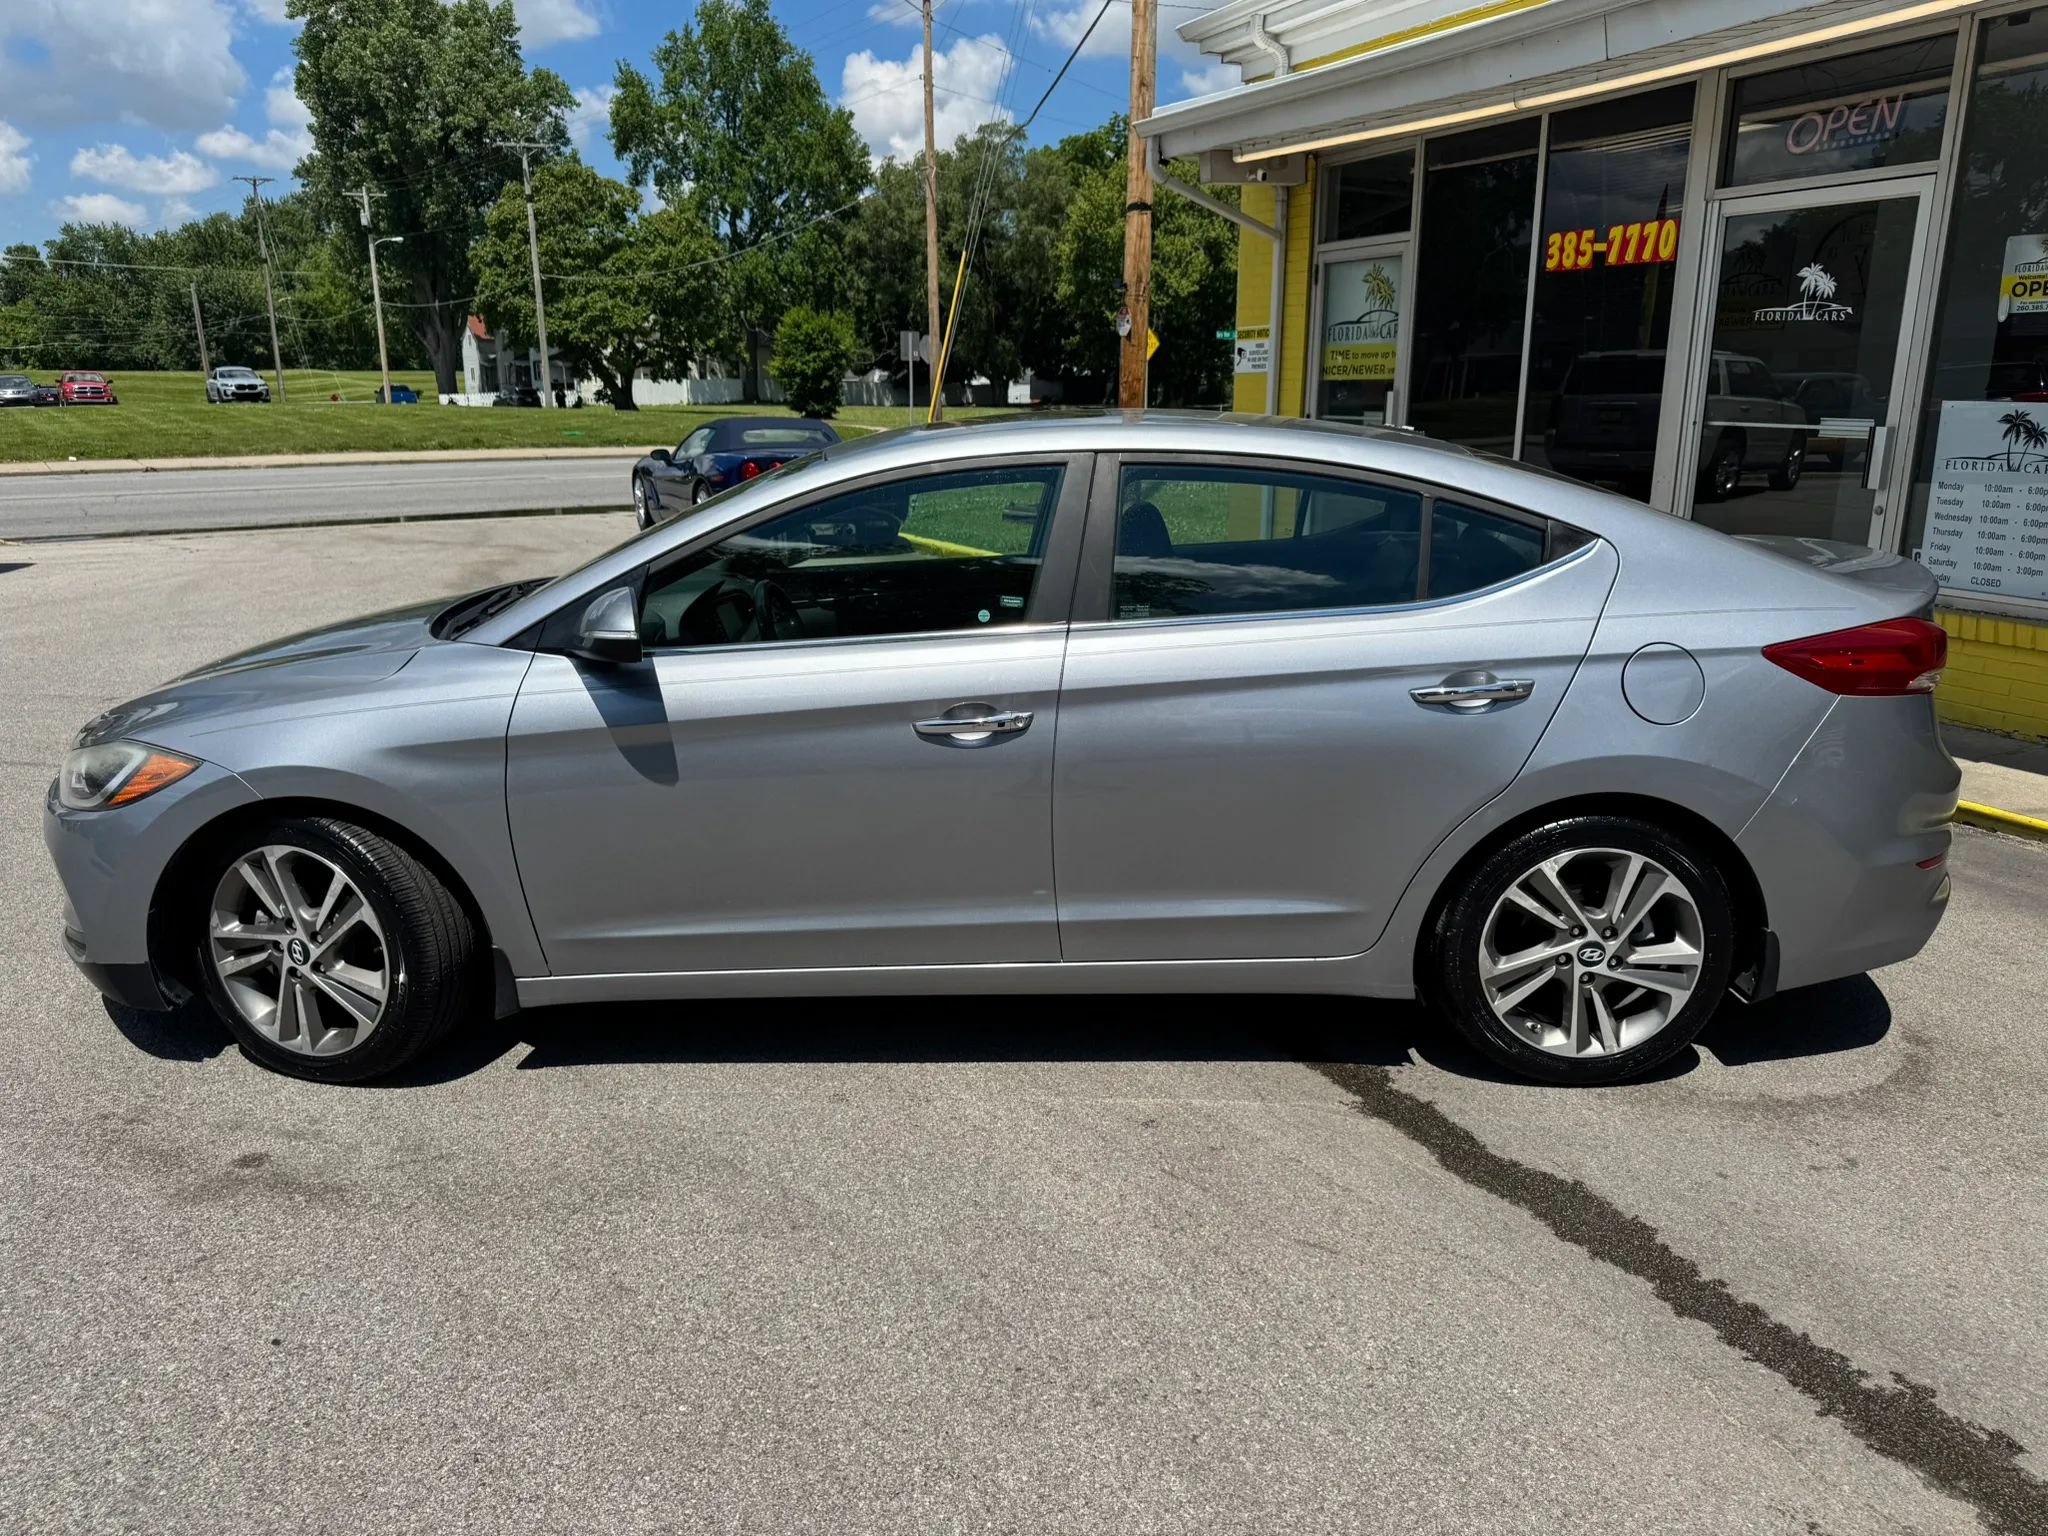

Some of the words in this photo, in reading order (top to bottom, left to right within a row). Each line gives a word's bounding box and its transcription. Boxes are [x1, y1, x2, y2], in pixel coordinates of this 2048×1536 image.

[1786, 93, 1904, 154] OPEN
[1545, 219, 1677, 270] 385-7770
[2015, 264, 2044, 273] FLORIDA
[1754, 311, 1801, 321] FLORIDA
[1815, 311, 1846, 320] CARS
[1257, 328, 1270, 338] NOTIC
[1328, 326, 1368, 342] FLORIDA
[1330, 350, 1351, 360] TIME
[1352, 351, 1359, 359] to
[1361, 351, 1379, 359] move
[1381, 351, 1389, 361] up
[1321, 364, 1386, 377] NICER/NEWER
[1945, 460, 2004, 472] FLORIDA
[1938, 481, 1964, 492] Monday
[1984, 484, 2013, 493] 10:00am
[1936, 496, 1964, 508] Tuesday
[1982, 499, 2011, 509] 10:00am
[1934, 512, 1973, 525] Wednesday
[1980, 515, 2009, 525] 10:00am
[1933, 527, 1963, 539] Thursday
[1978, 531, 2006, 541] 10:00am
[2020, 534, 2048, 545] 6:00pm
[1930, 542, 1951, 553] Friday
[1975, 546, 2004, 556] 10:00am
[2018, 550, 2046, 561] 6:00pm
[1928, 556, 1958, 569] Saturday
[1973, 562, 2002, 572] 10:00am
[2016, 565, 2044, 576] 3:00pm
[1935, 573, 1951, 584] nday
[1970, 576, 2001, 588] CLOSED
